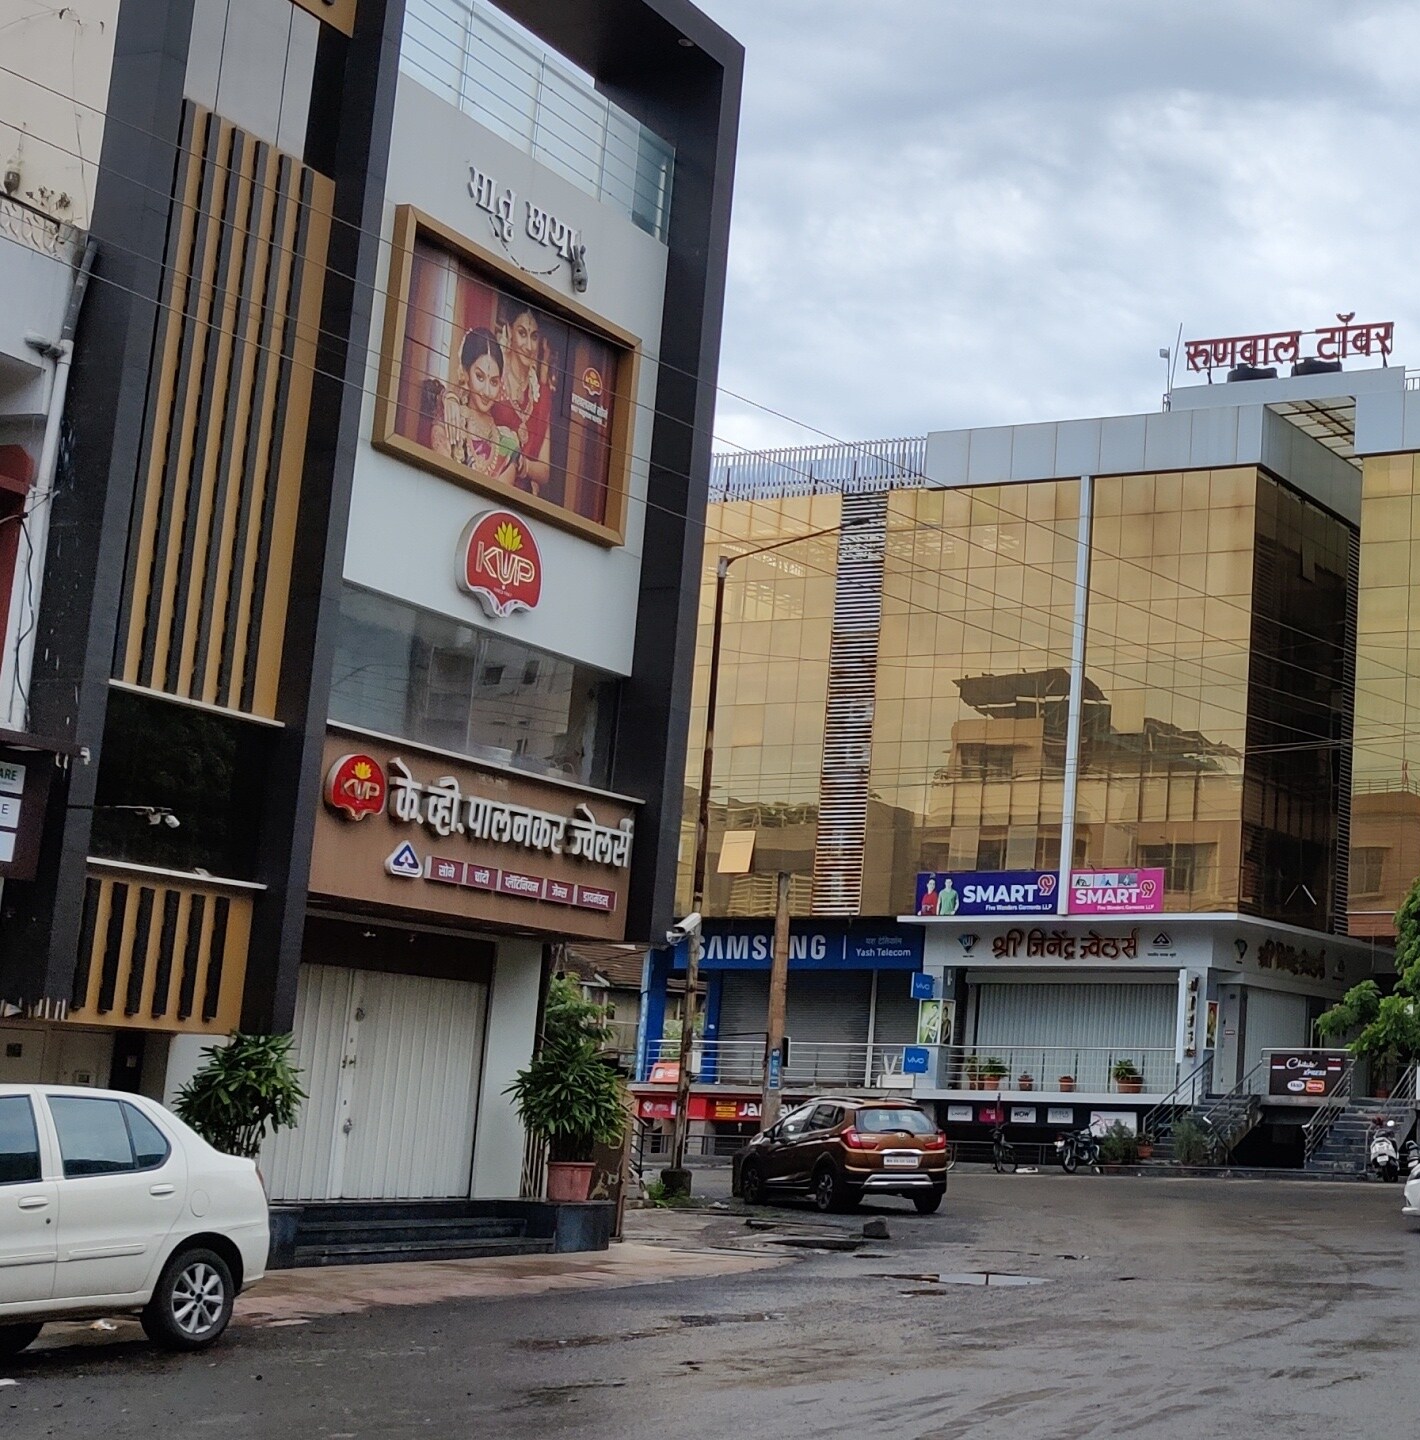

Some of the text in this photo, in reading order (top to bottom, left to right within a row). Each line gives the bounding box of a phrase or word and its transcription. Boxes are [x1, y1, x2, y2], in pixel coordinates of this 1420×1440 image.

[1315, 311, 1394, 360] टॉवर
[856, 948, 911, 957] Yash Telecom
[991, 927, 1025, 960] श्री
